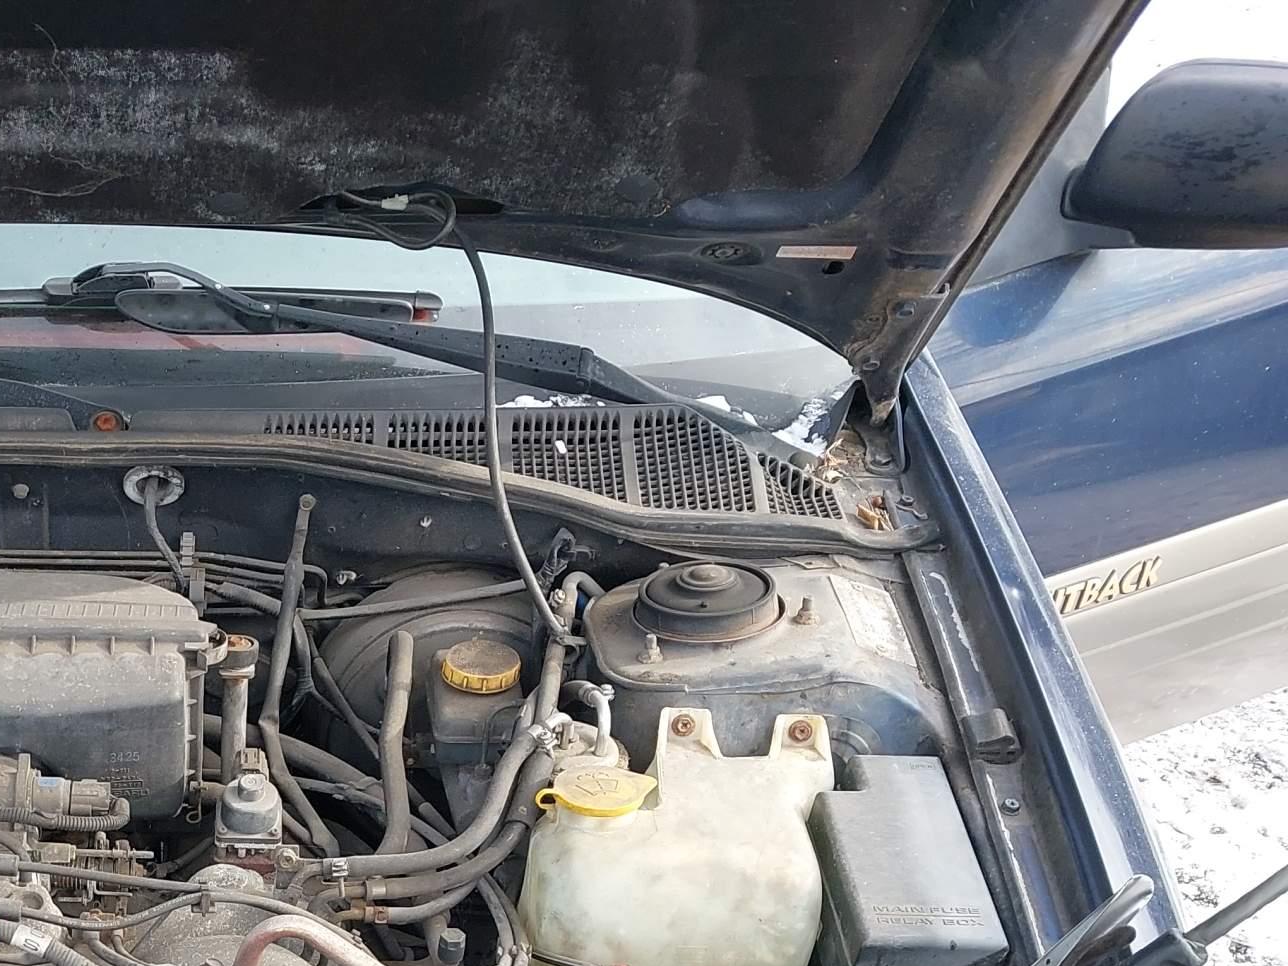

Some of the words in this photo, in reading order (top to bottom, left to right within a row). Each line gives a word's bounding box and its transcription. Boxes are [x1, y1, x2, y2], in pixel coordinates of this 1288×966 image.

[872, 904, 925, 914] MAIN
[929, 906, 981, 916] FUSE
[876, 916, 935, 926] RELAY
